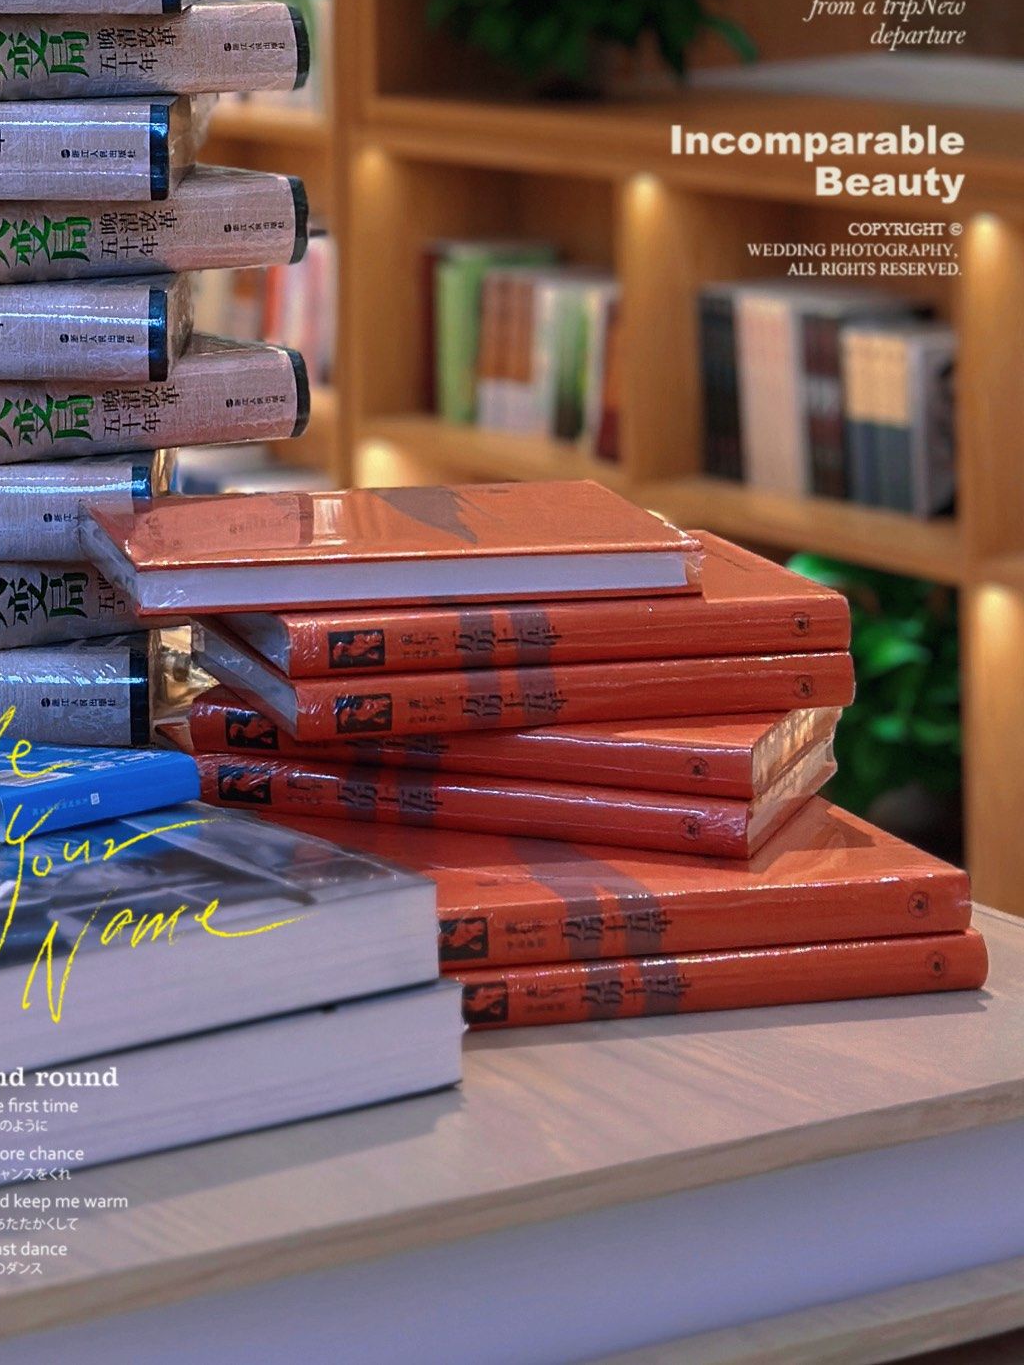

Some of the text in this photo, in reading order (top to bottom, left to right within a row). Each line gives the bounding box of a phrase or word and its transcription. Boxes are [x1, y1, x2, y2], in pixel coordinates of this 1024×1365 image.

[97, 25, 178, 51] 晚清改革
[99, 50, 160, 75] 五十年
[98, 208, 178, 234] 晚清改革
[100, 233, 160, 258] 五十年
[102, 383, 184, 413] 晚清改革
[103, 411, 162, 437] 五十年
